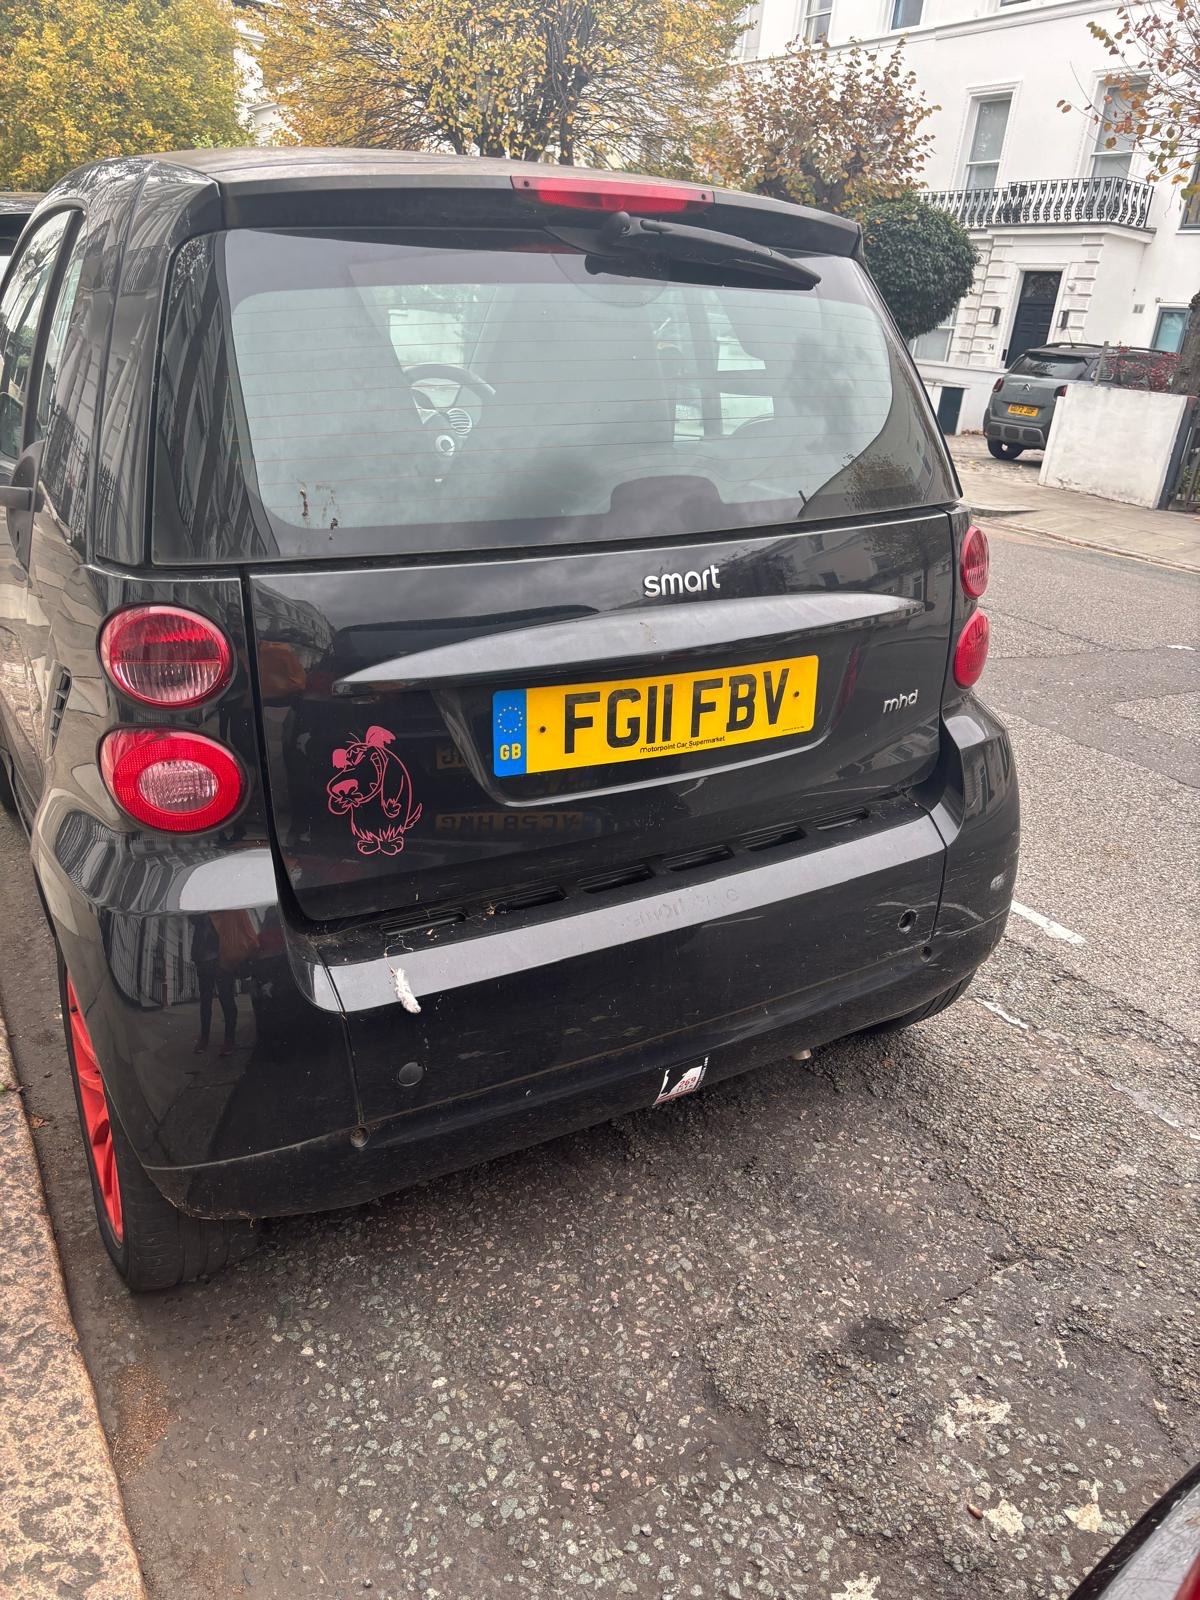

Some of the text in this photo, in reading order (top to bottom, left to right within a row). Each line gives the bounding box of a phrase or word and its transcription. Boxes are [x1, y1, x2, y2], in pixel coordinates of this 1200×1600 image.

[644, 565, 721, 598] smart
[564, 667, 790, 755] FG11 FBV
[882, 688, 919, 714] mhd
[500, 743, 522, 761] GB
[676, 741, 688, 749] Car
[688, 735, 726, 748] Supermarket
